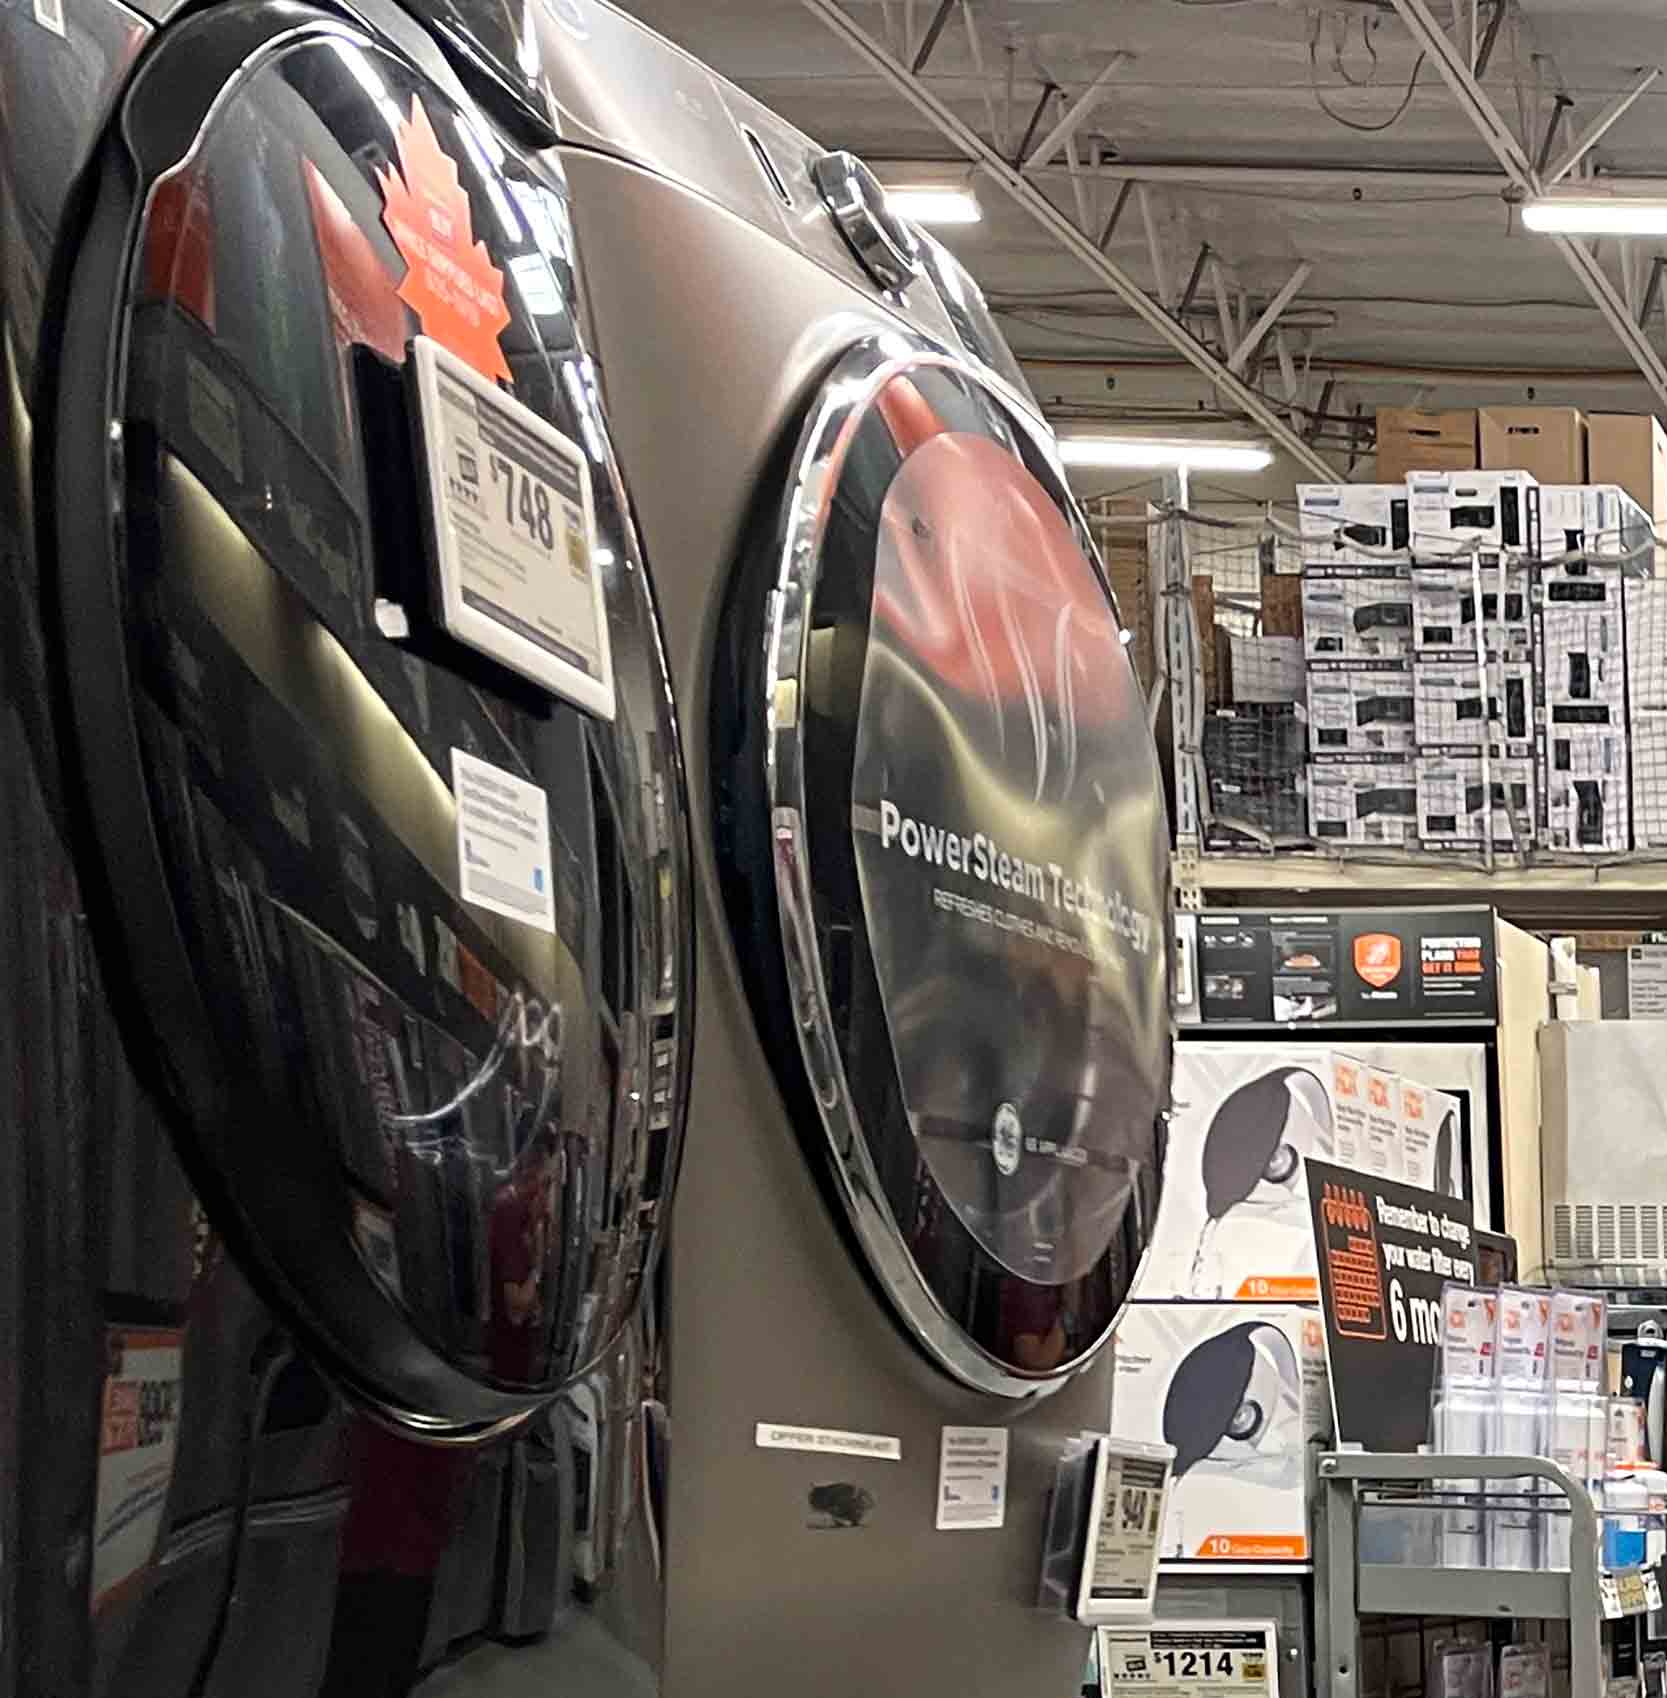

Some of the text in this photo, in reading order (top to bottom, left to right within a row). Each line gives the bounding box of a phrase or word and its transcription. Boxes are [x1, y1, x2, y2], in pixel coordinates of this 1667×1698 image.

[488, 452, 555, 552] $748
[880, 799, 1047, 903] PowerSteam
[1375, 1195, 1471, 1250] Remember to change
[1382, 1243, 1405, 1271] your
[1405, 1245, 1431, 1271] water
[1431, 1247, 1452, 1277] filter
[1247, 1280, 1270, 1296] 10
[1389, 1277, 1408, 1343] 6
[1209, 1538, 1231, 1556] 10
[1153, 1651, 1233, 1676] $1214
